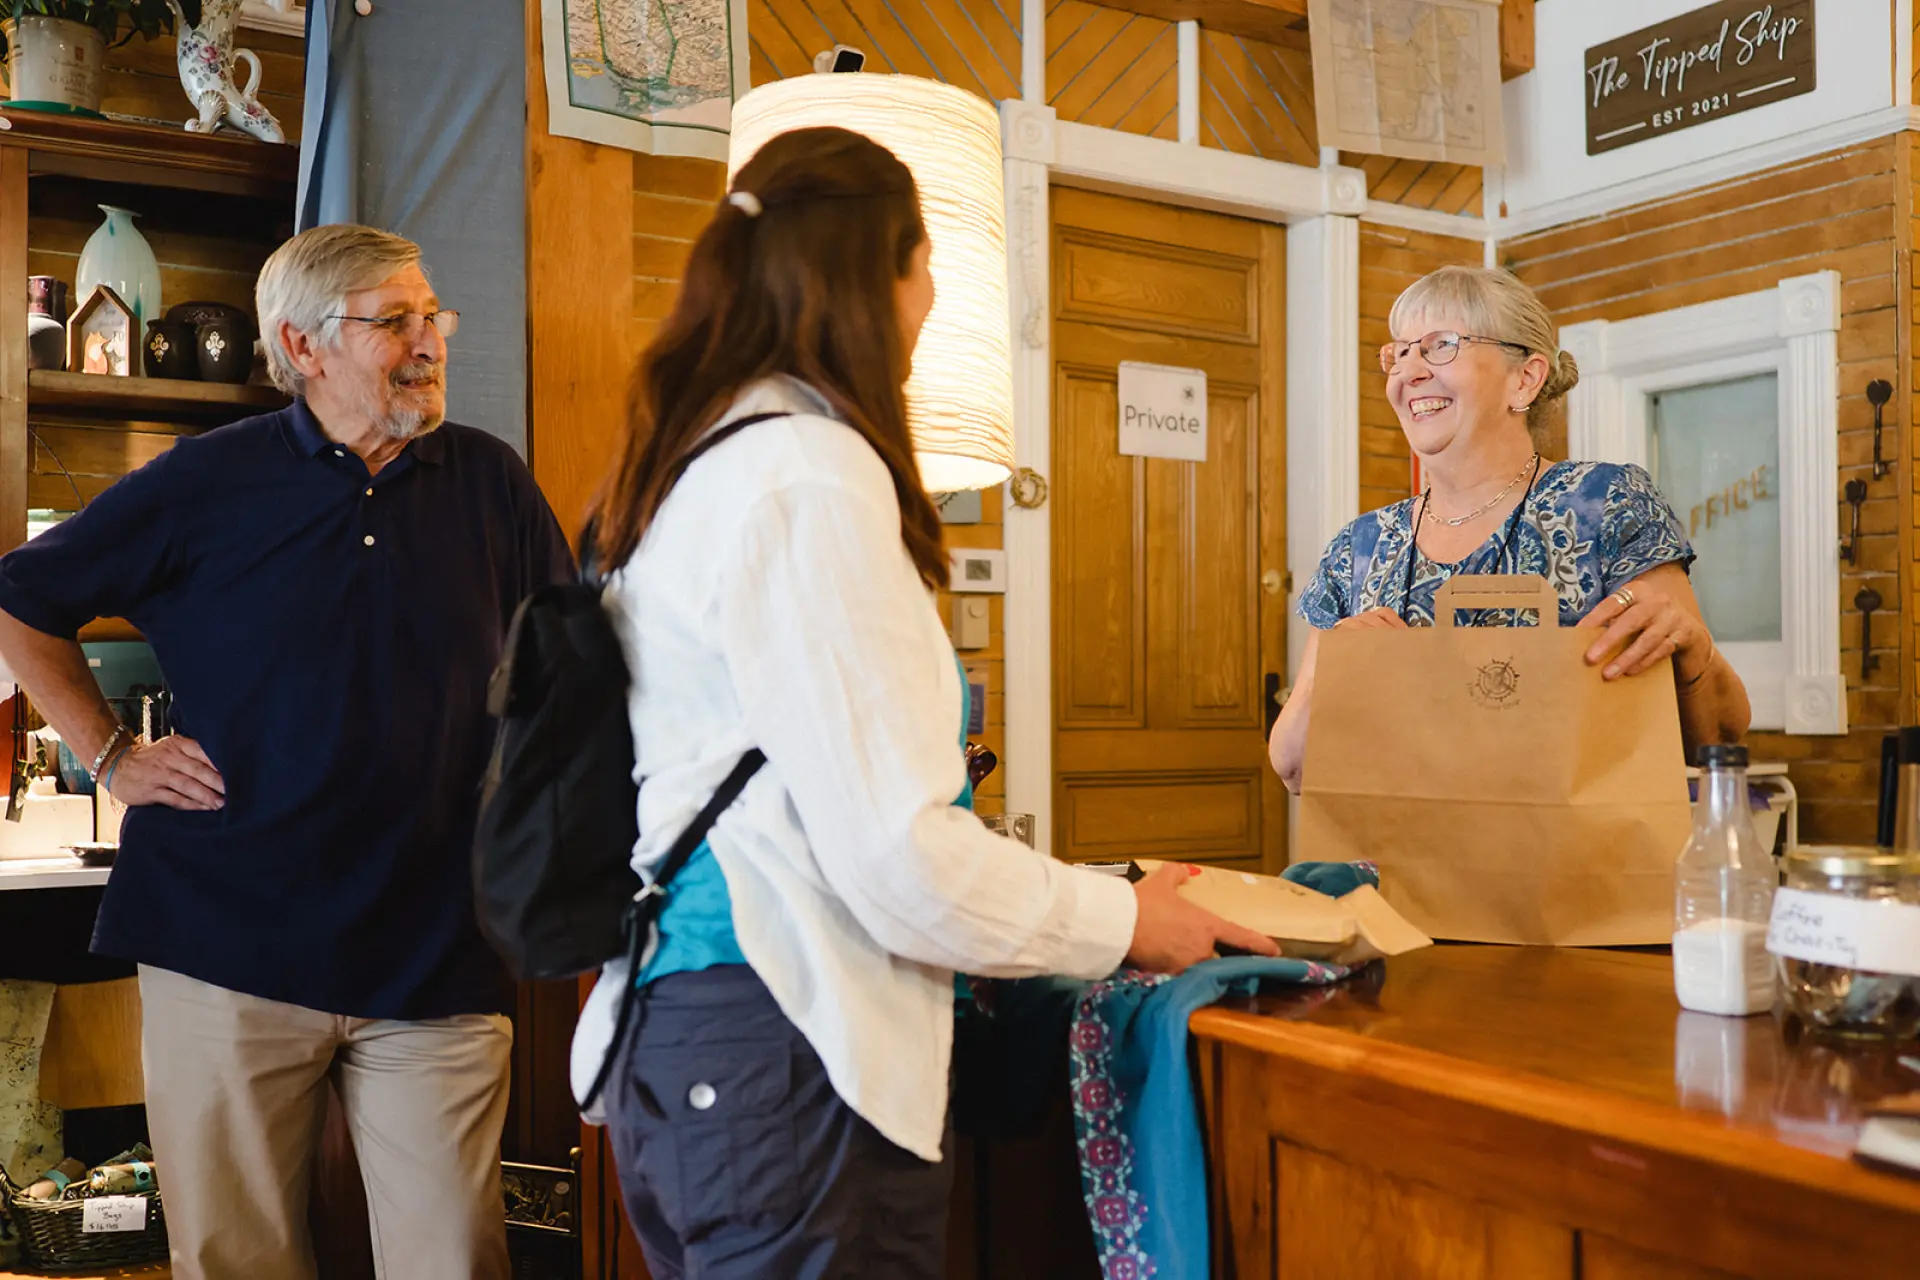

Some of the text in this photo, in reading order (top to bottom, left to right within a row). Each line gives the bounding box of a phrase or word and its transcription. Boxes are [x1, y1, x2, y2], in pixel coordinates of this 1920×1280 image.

[1587, 4, 1804, 108] The Tipped Ship
[1652, 92, 1730, 128] EST 2021
[1124, 404, 1200, 434] Private
[1689, 464, 1768, 538] FFICE
